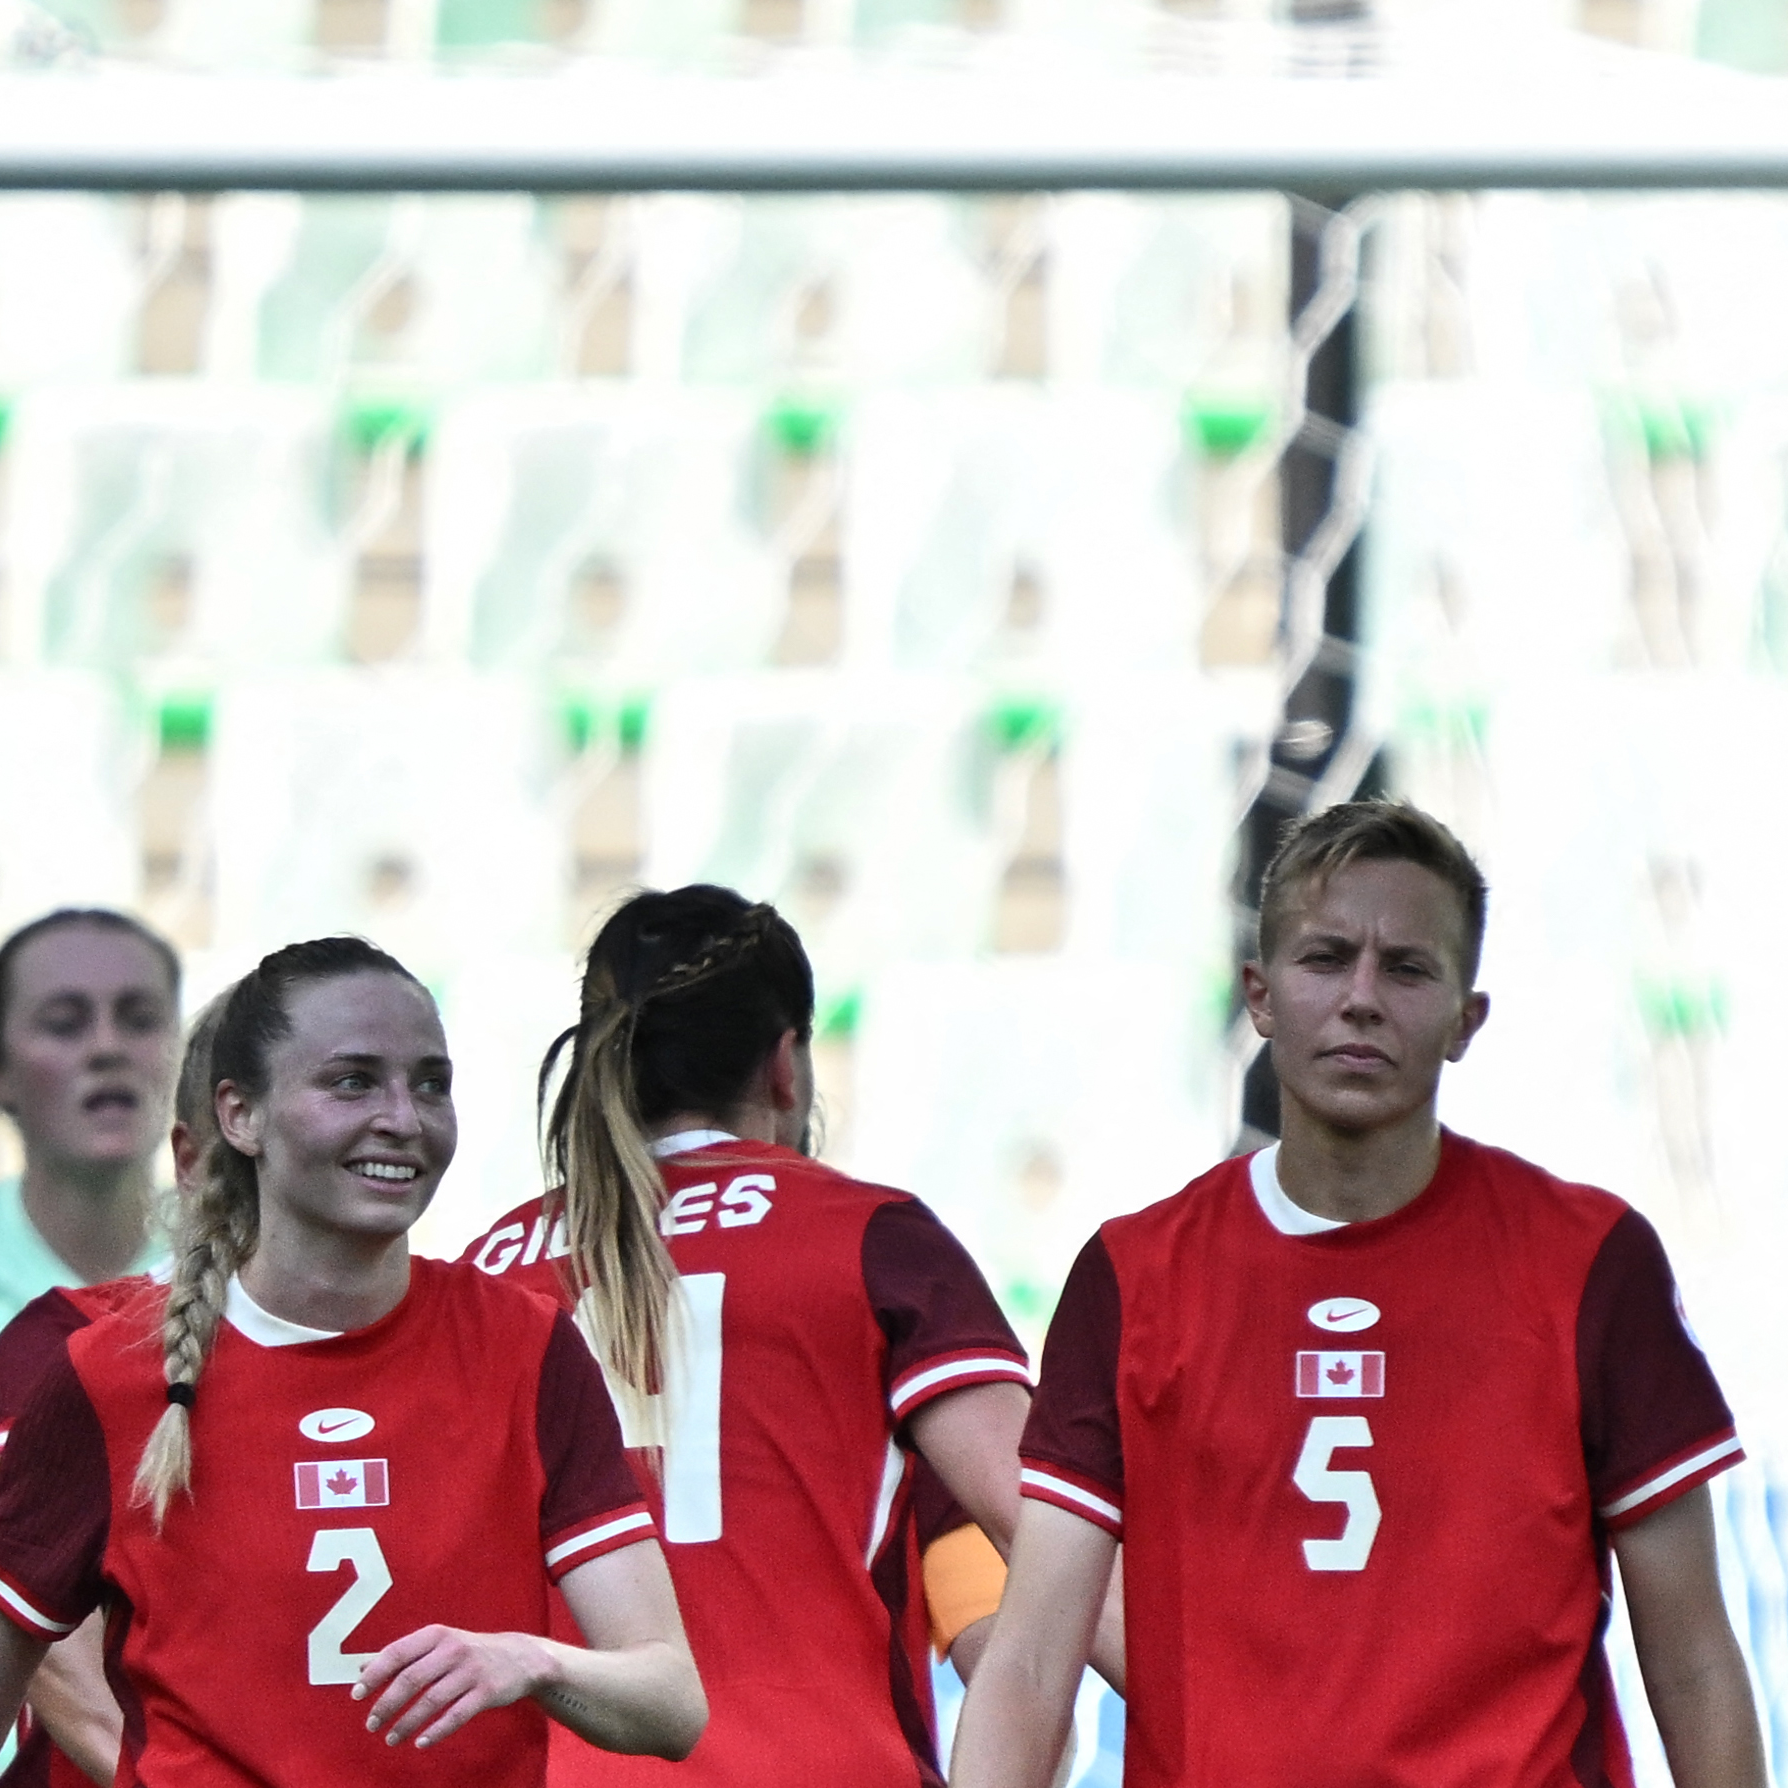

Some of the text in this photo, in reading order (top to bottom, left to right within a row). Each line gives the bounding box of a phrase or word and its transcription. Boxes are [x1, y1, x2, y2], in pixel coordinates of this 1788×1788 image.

[473, 1174, 777, 1276] GILES
[1292, 1415, 1383, 1572] 5
[305, 1527, 395, 1685] 2
